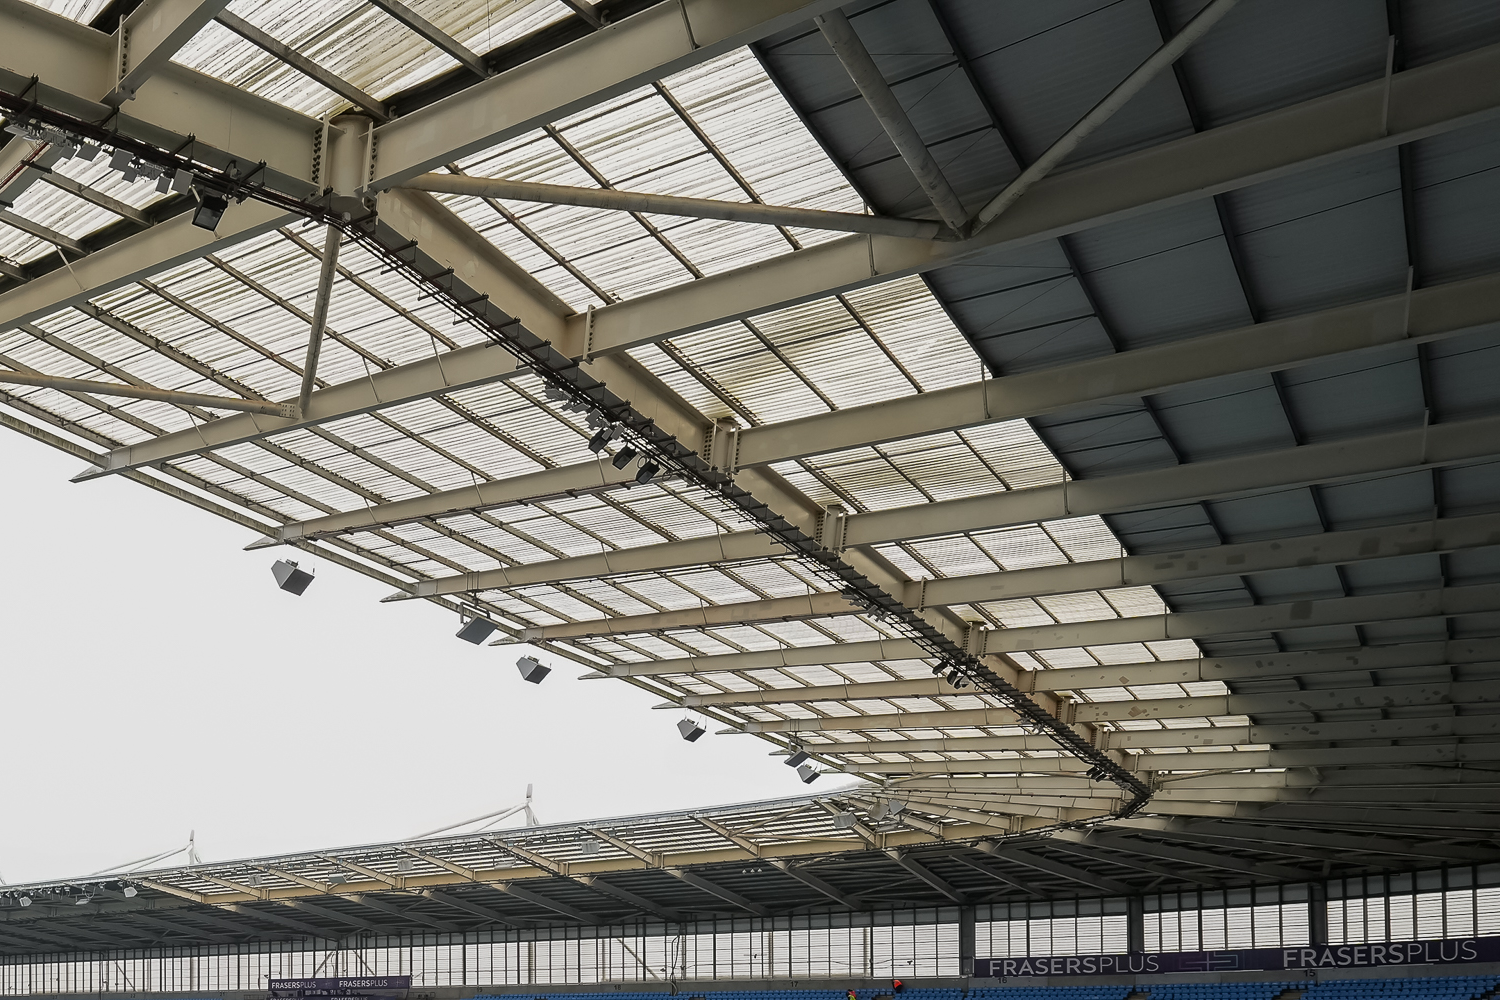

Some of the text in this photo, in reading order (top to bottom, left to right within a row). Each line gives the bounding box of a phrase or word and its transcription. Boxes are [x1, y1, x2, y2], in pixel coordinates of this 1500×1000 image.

[1283, 940, 1477, 967] FRASERSPLUS
[989, 955, 1159, 976] FRASERSPLUS
[1303, 968, 1316, 978] 15
[271, 981, 316, 989] FRASERSPLUS
[339, 979, 388, 988] FRASERSPLUS
